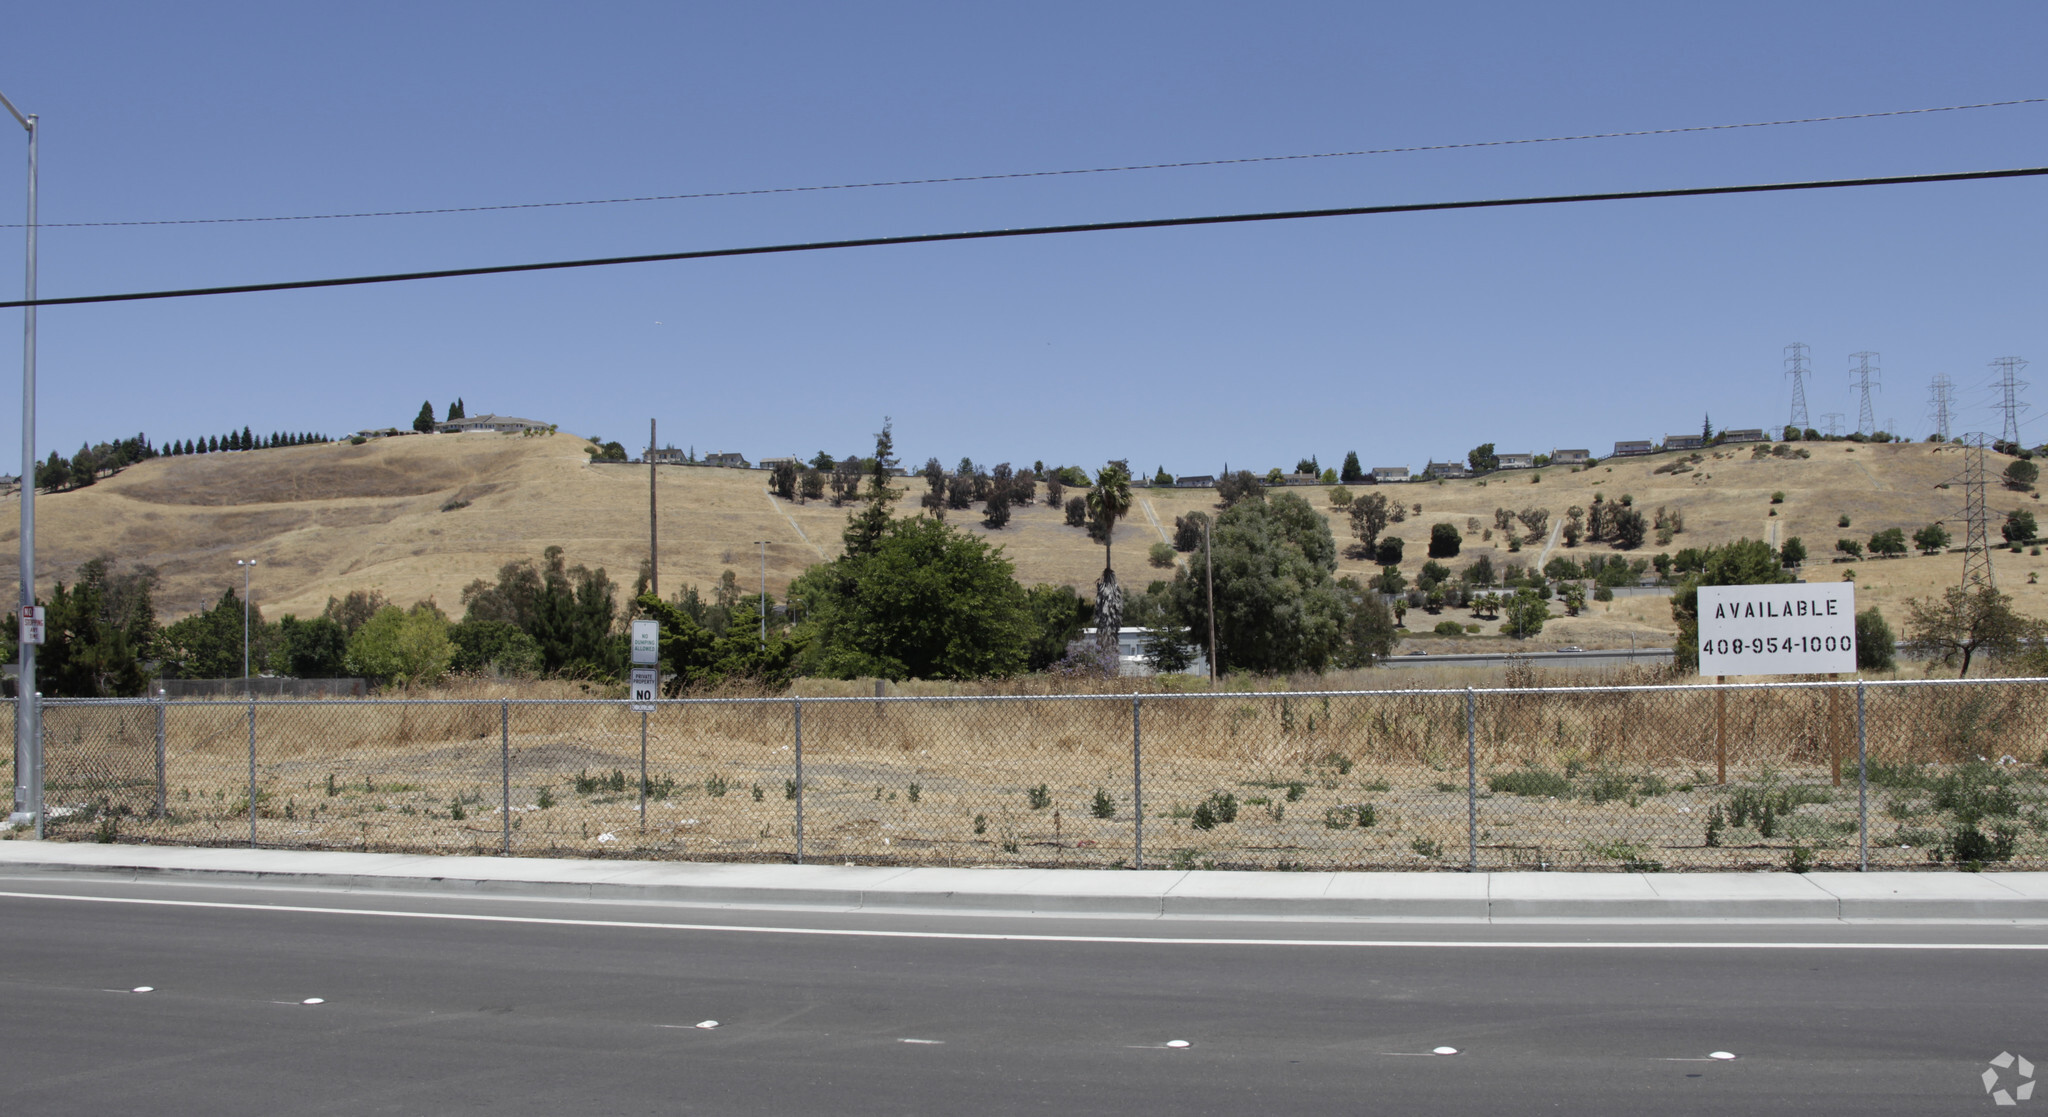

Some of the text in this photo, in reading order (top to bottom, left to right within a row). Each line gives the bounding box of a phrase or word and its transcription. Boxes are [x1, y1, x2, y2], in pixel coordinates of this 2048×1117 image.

[24, 608, 32, 616] NO
[1715, 599, 1838, 619] AVAILABLE
[1703, 635, 1852, 656] 408-954-1000
[636, 690, 651, 700] NO
